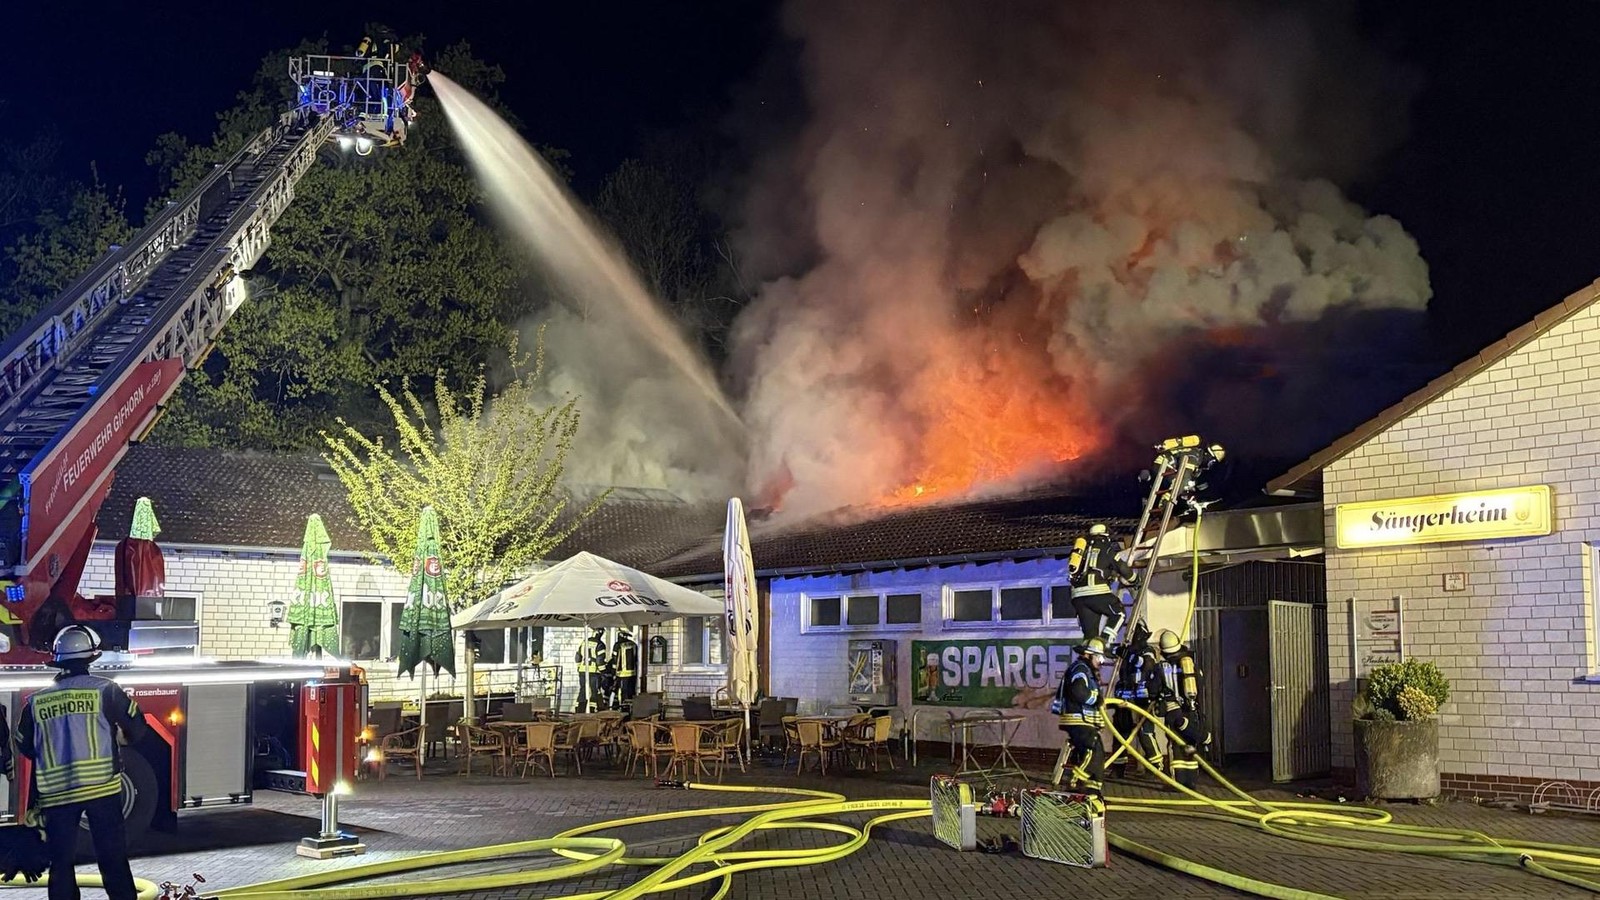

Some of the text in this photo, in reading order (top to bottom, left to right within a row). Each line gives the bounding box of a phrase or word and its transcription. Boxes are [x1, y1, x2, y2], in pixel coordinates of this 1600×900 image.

[63, 422, 113, 492] FEUERWEHR
[113, 384, 144, 432] GIFHORN
[1370, 502, 1508, 533] Sängerheim
[941, 645, 1079, 688] SPARGE
[135, 688, 178, 697] rosenbauer
[38, 700, 94, 721] GIFHORN
